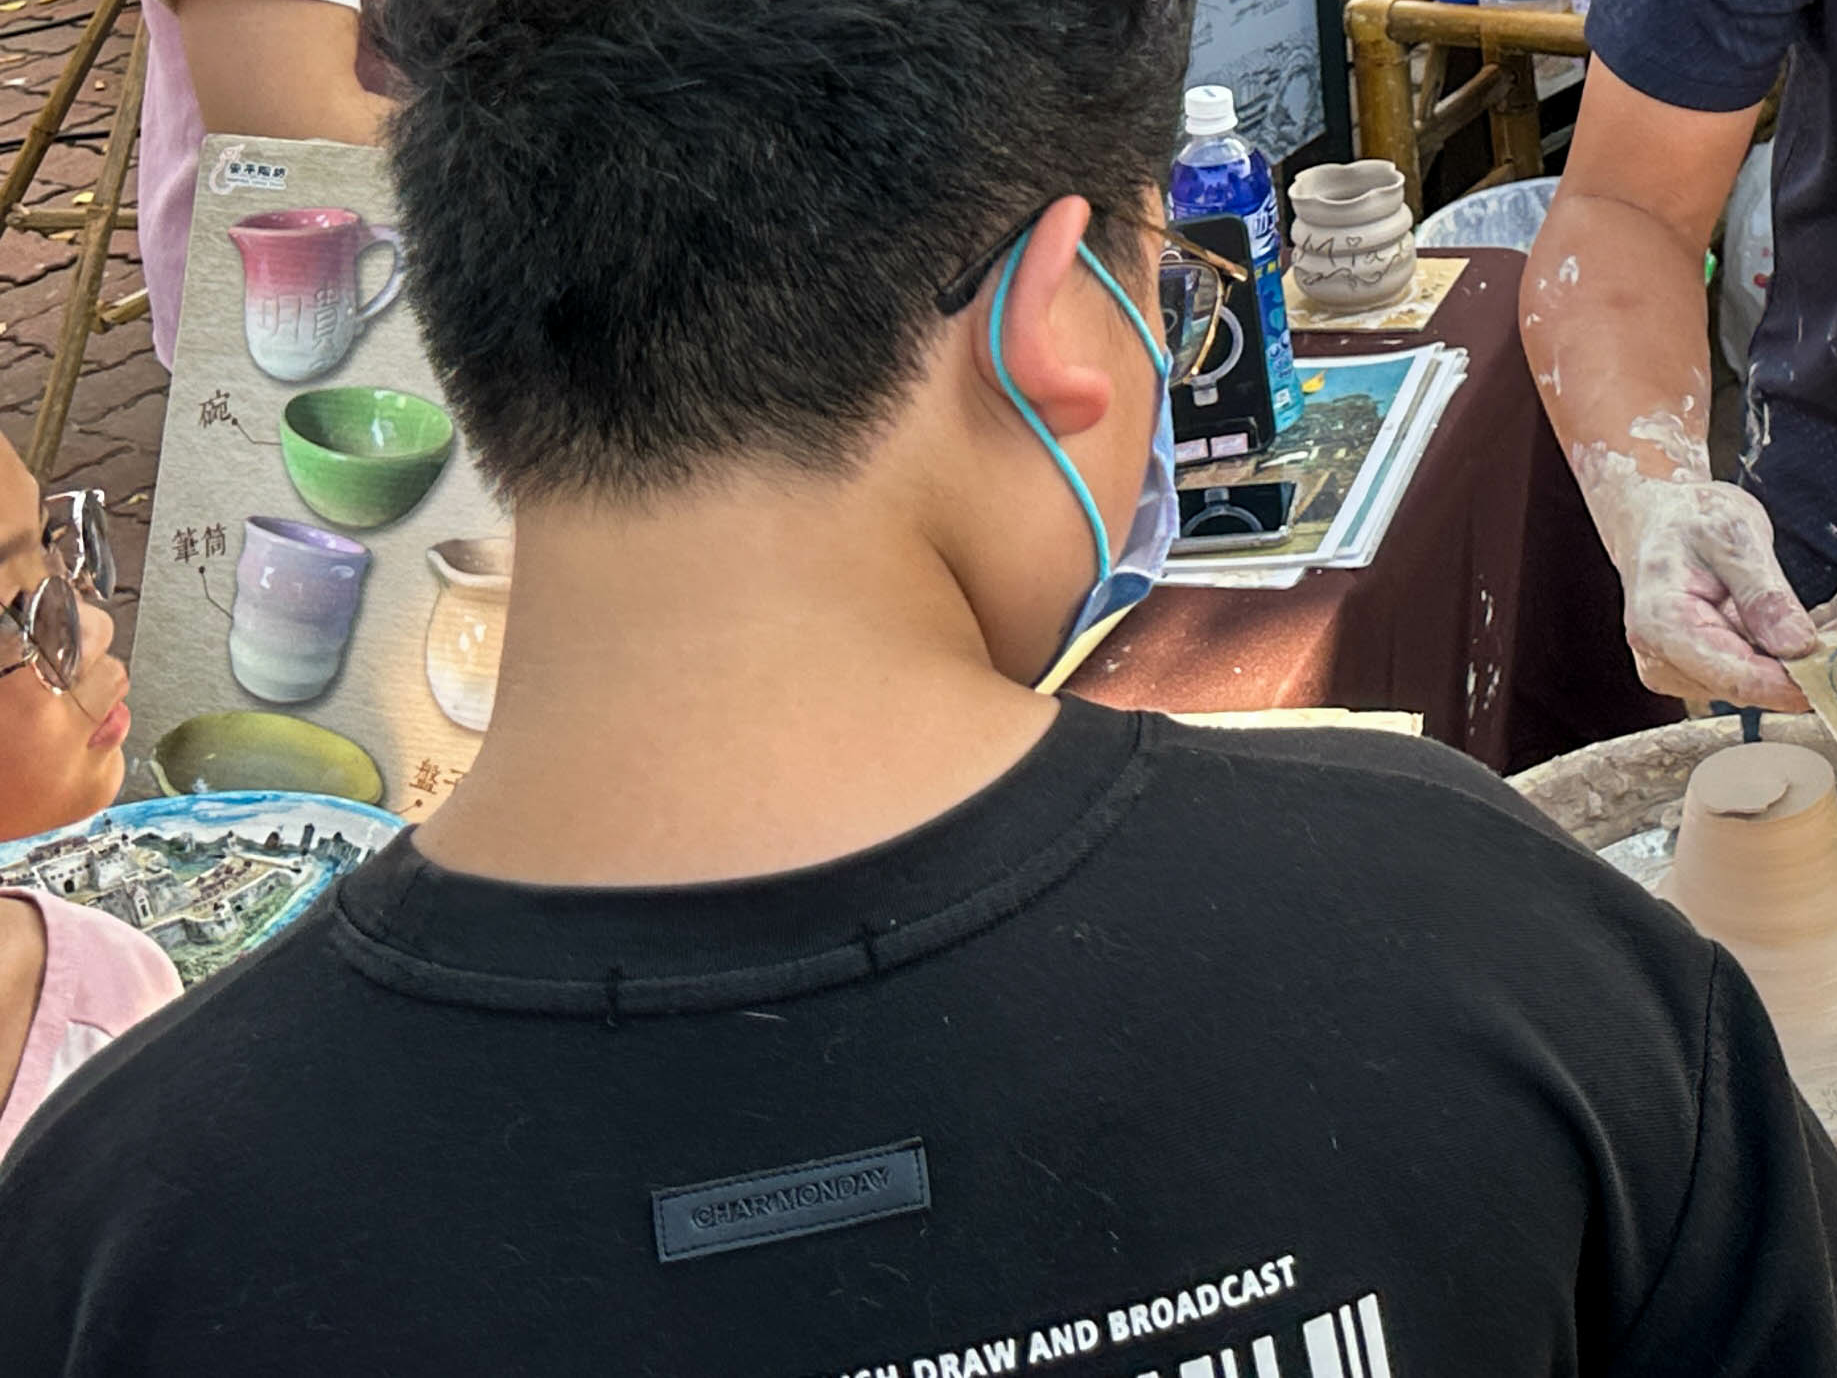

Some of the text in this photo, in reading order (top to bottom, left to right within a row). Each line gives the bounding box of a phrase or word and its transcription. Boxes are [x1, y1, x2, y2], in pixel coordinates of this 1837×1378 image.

[199, 389, 233, 429] 碗
[912, 1255, 1297, 1378] DRAW AND BROADCAST
